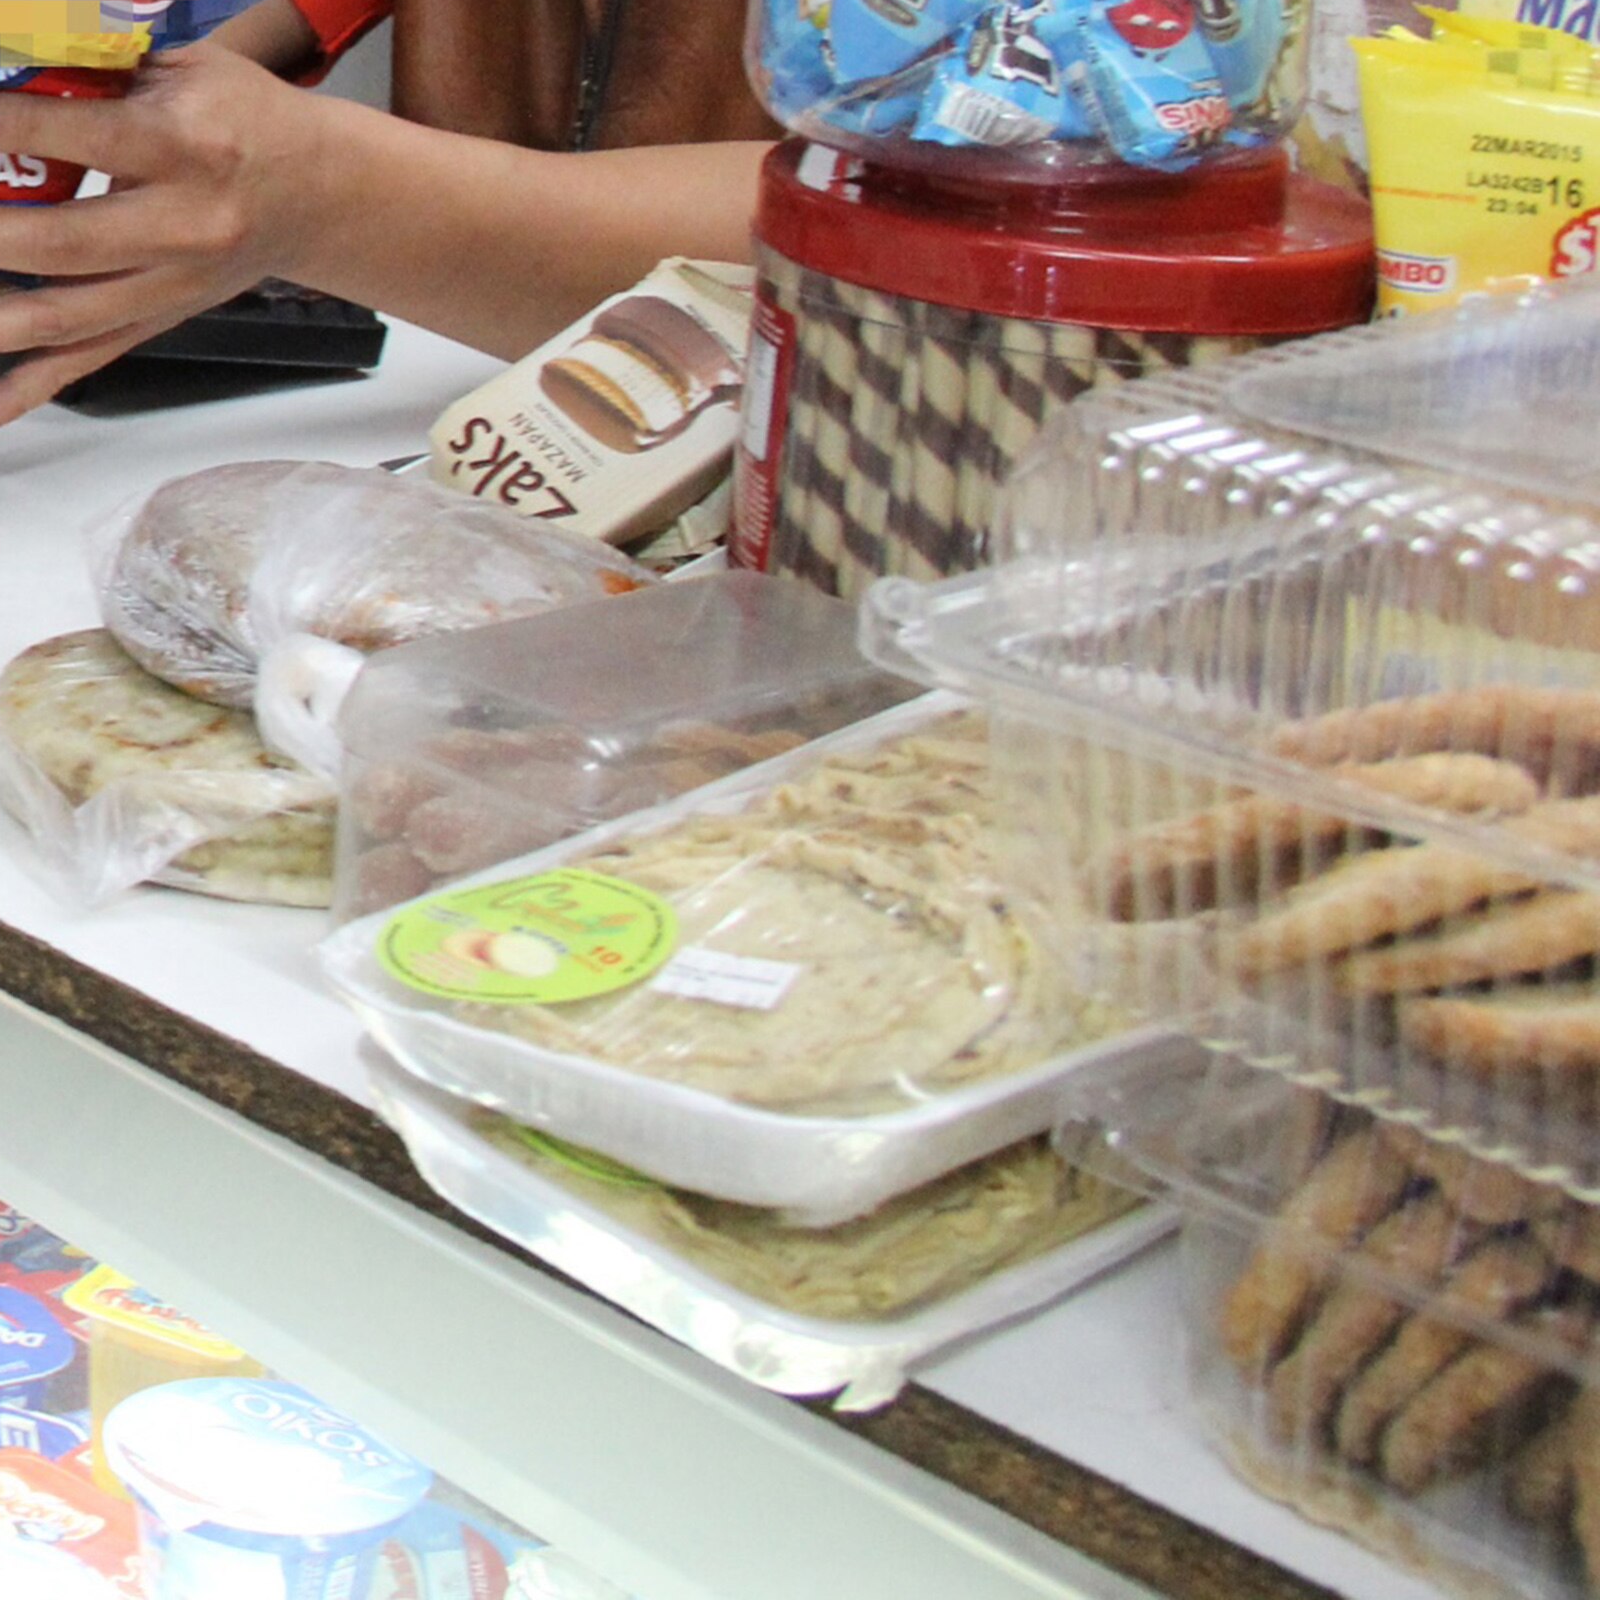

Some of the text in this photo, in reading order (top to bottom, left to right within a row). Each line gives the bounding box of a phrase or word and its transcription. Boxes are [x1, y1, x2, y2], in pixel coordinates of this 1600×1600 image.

[1471, 134, 1583, 164] 22MAR2015
[1547, 175, 1585, 209] 16
[230, 1391, 391, 1467] OIKOS
